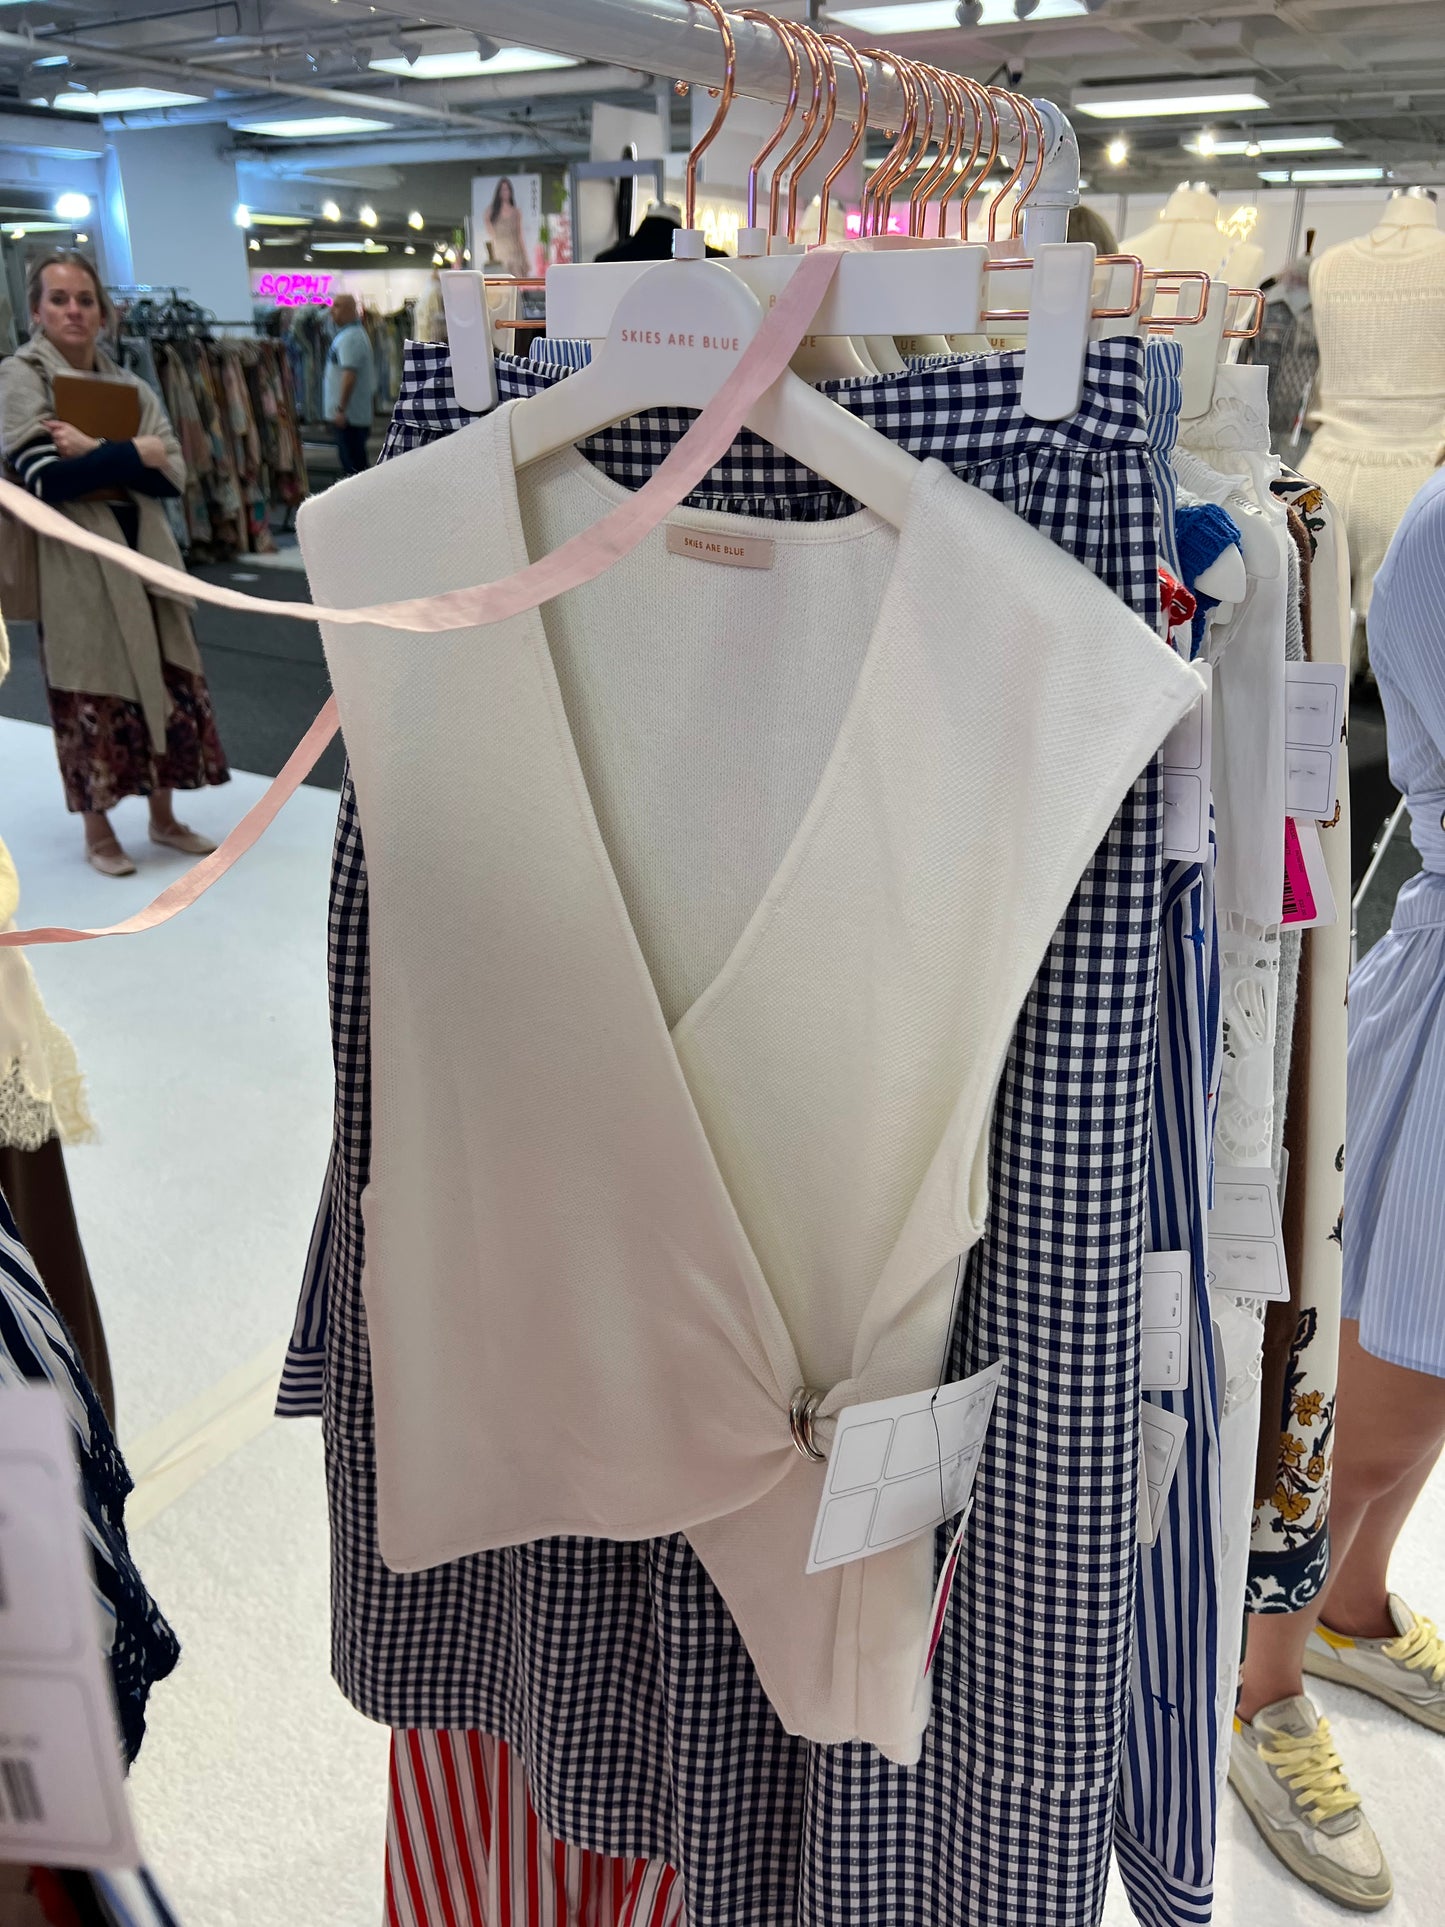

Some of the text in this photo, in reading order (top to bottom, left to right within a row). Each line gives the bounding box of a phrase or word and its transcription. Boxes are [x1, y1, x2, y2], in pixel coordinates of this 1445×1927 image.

[621, 329, 739, 351] SKIES ARE BLUE
[900, 340, 917, 351] UE
[990, 338, 1006, 347] UE
[684, 537, 745, 556] SKIES ARE BLUE
